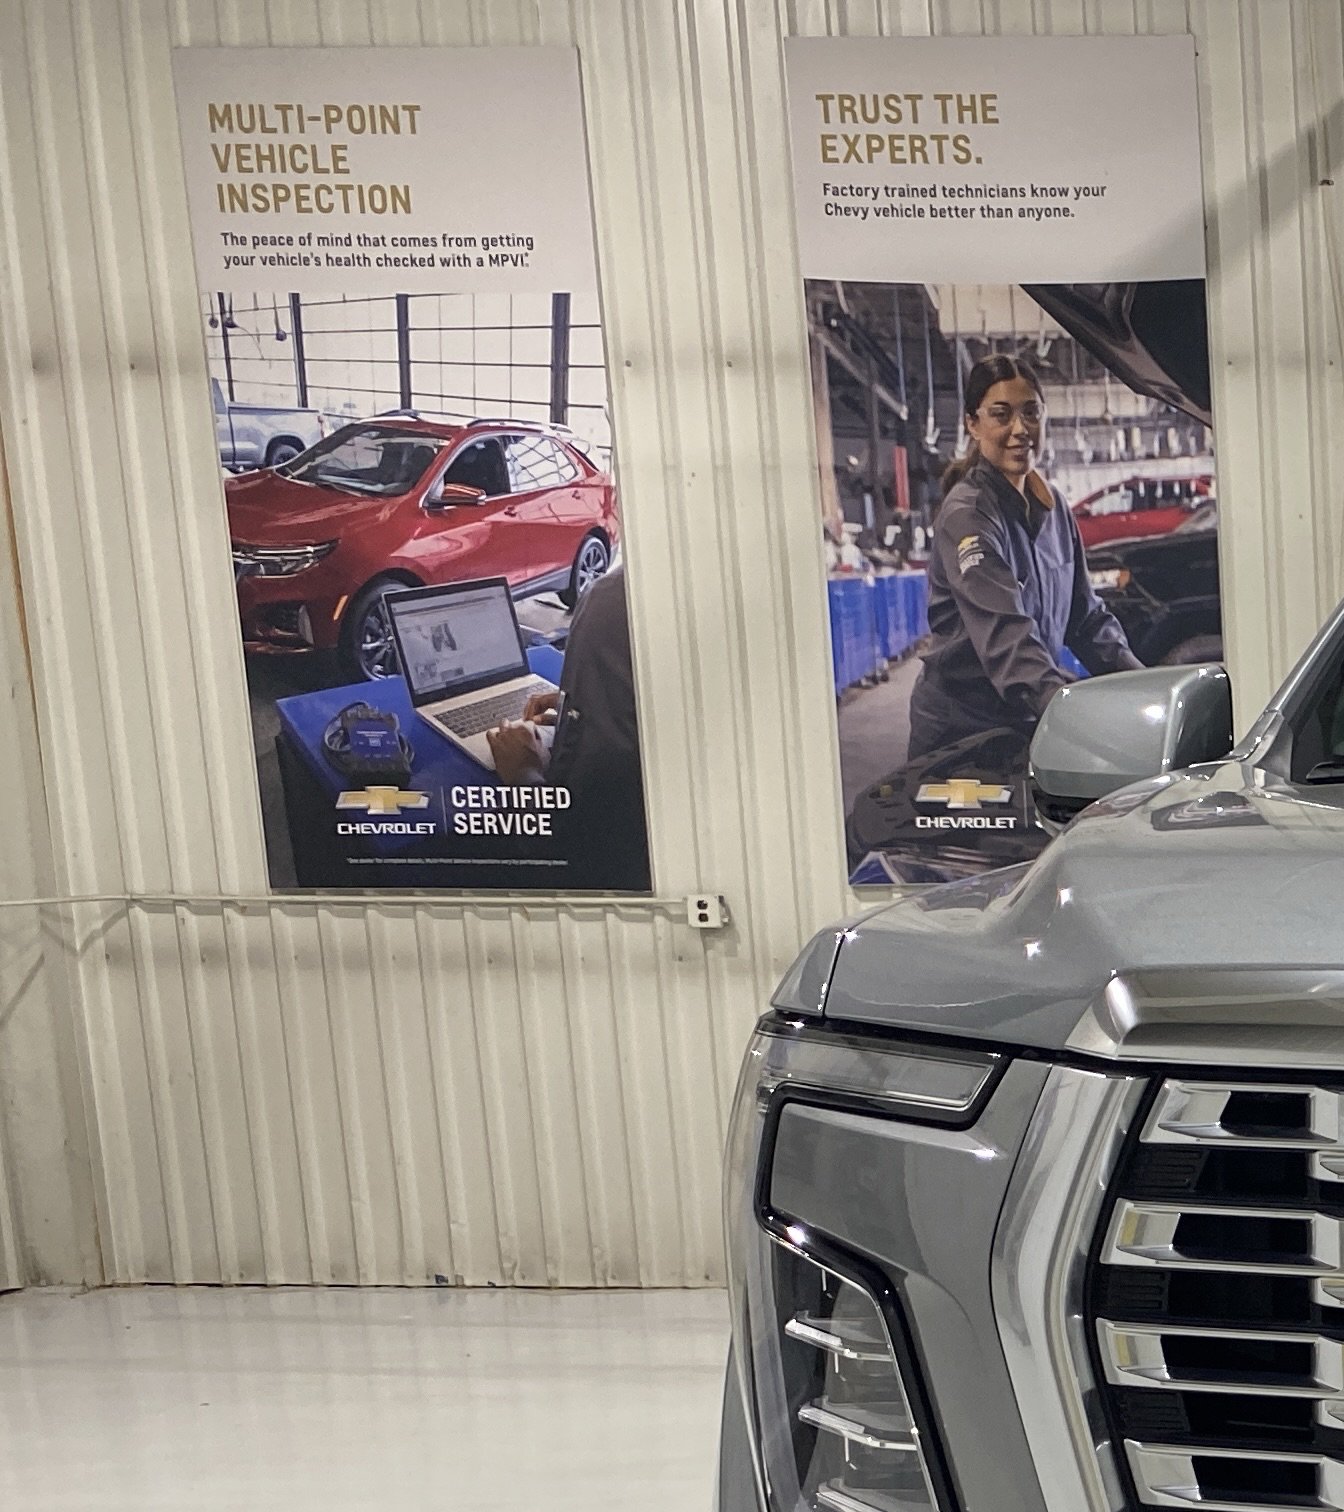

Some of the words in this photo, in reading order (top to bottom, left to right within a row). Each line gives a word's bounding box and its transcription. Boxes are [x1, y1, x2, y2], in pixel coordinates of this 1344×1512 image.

[207, 103, 421, 134] MULTI-POINT
[816, 93, 924, 124] TRUST
[933, 93, 1000, 124] THE
[210, 143, 351, 175] VEHICLE
[820, 133, 983, 165] EXPERTS.
[215, 183, 412, 214] INSPECTION
[822, 183, 880, 200] Factory
[884, 183, 937, 198] trained
[942, 183, 1026, 198] technicians
[1030, 183, 1070, 198] know
[1073, 185, 1107, 200] your
[824, 202, 870, 221] Chevy
[873, 203, 925, 218] vehicle
[929, 203, 976, 218] better
[980, 204, 1013, 218] than
[1018, 206, 1075, 221] anyone.
[220, 232, 247, 246] The
[251, 234, 294, 250] peace
[298, 232, 312, 247] of
[316, 232, 352, 247] mind
[355, 232, 387, 248] that
[391, 235, 438, 248] comes
[441, 233, 477, 248] from
[481, 233, 534, 251] getting
[223, 254, 255, 270] your
[259, 252, 322, 267] vehicle's
[325, 252, 371, 267] health
[375, 253, 435, 268] checked
[439, 253, 471, 268] with
[476, 256, 484, 268] a
[451, 785, 571, 810] CERTIFIED
[336, 822, 437, 835] CHEVROLET
[453, 813, 553, 836] SERVICE
[915, 815, 1017, 829] CHEVROLET
